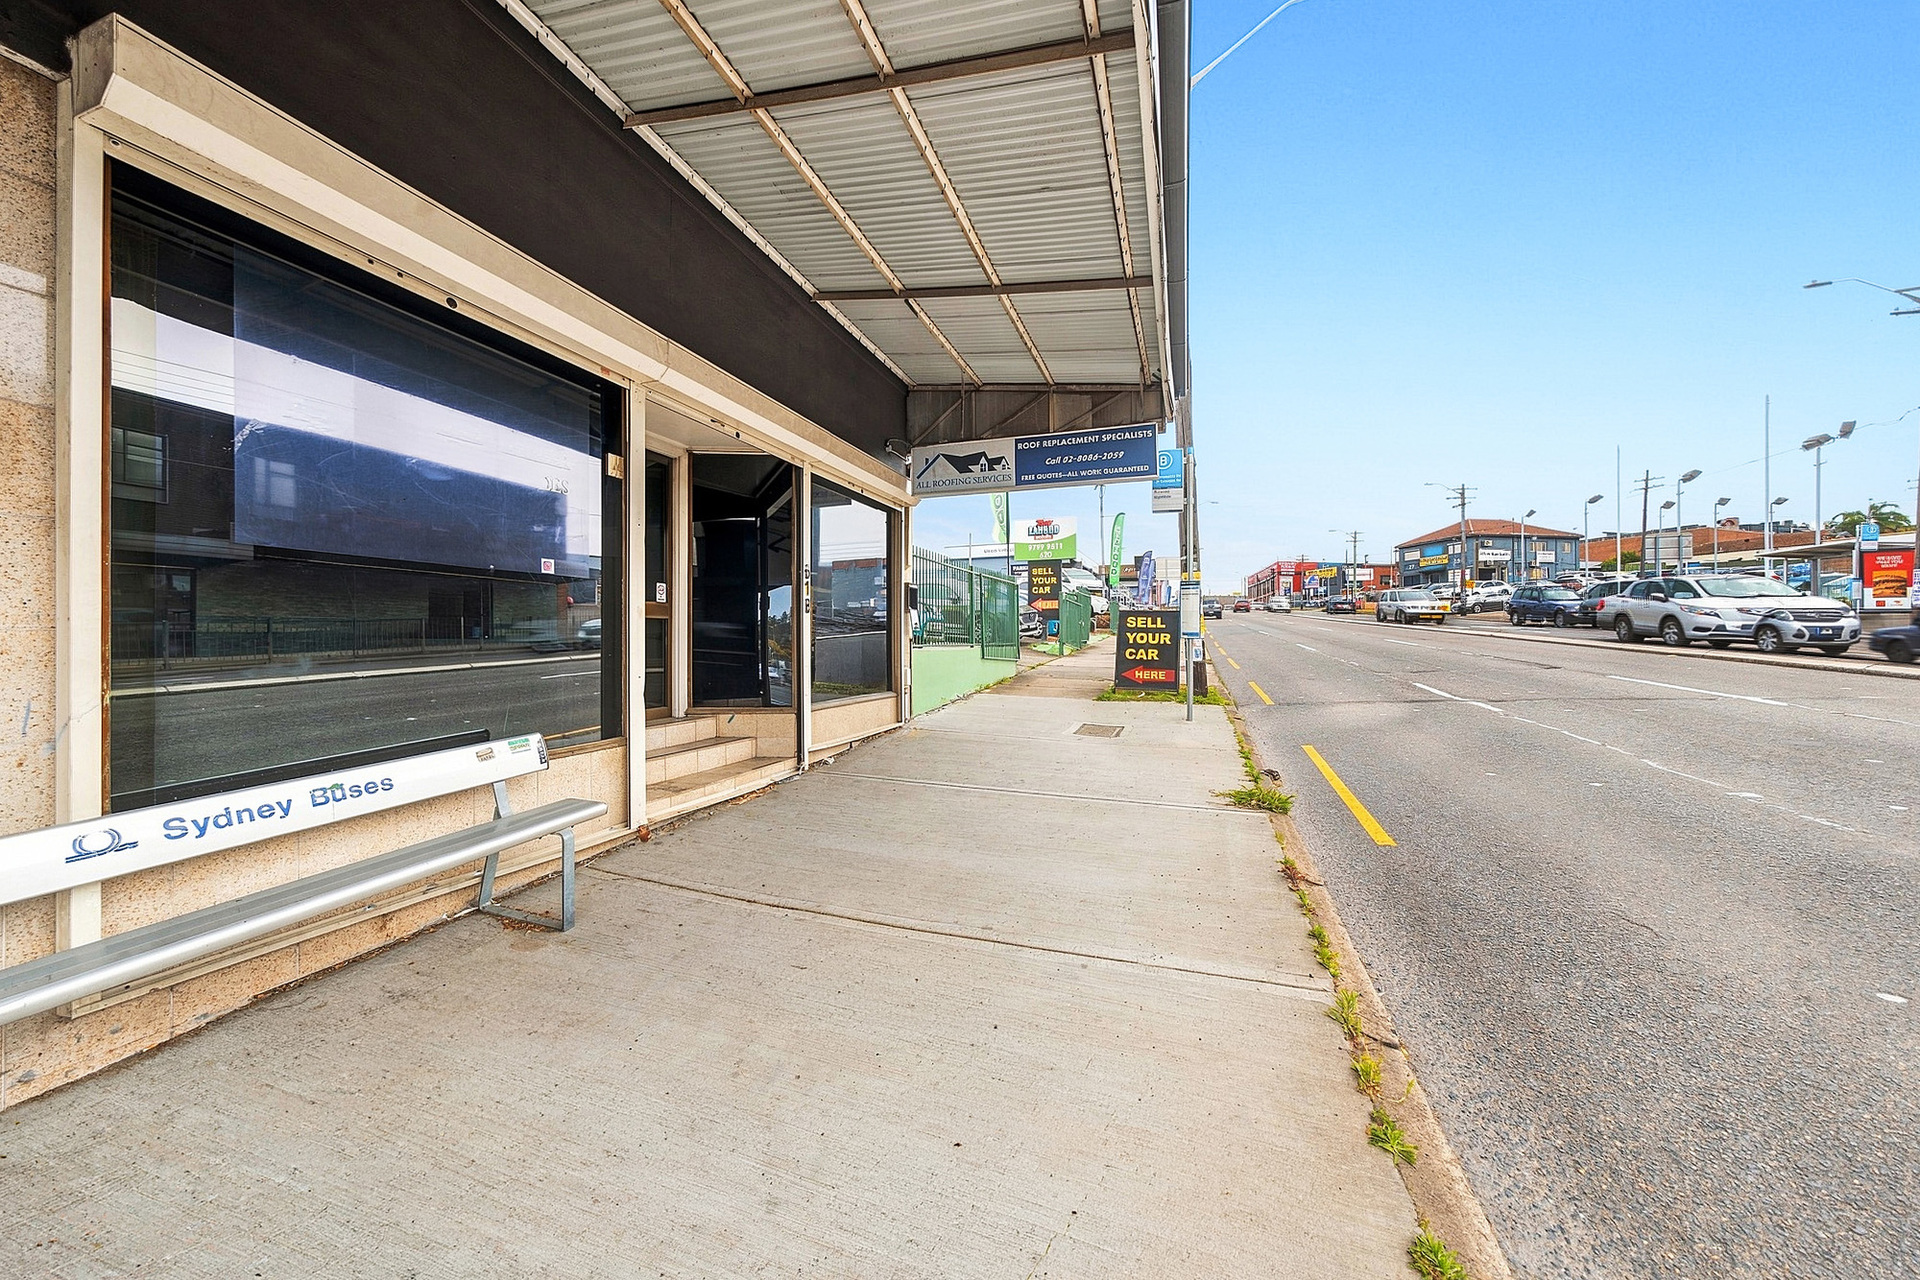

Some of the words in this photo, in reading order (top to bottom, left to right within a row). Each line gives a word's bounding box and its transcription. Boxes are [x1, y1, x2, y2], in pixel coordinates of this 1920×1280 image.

[1017, 441, 1041, 450] ROOF
[1042, 435, 1099, 448] REPLACEMENT
[1101, 430, 1153, 442] SPECIALISTS
[1045, 456, 1061, 465] Call
[1062, 451, 1124, 463] 02-8086-2059
[1080, 469, 1102, 477] WORK
[1103, 465, 1149, 475] GUARANTEED
[916, 481, 931, 489] ALL
[932, 477, 971, 487] ROOFING
[973, 473, 1012, 484] SERVICES
[1031, 567, 1054, 575] SELL
[1031, 577, 1057, 585] YOUR
[1031, 586, 1051, 594] CAR
[1126, 616, 1166, 629] SELL
[1125, 632, 1172, 645] YOUR
[1125, 648, 1160, 661] CAR
[1134, 670, 1166, 680] HERE
[162, 799, 293, 840] Sydney
[310, 778, 395, 808] Buses
